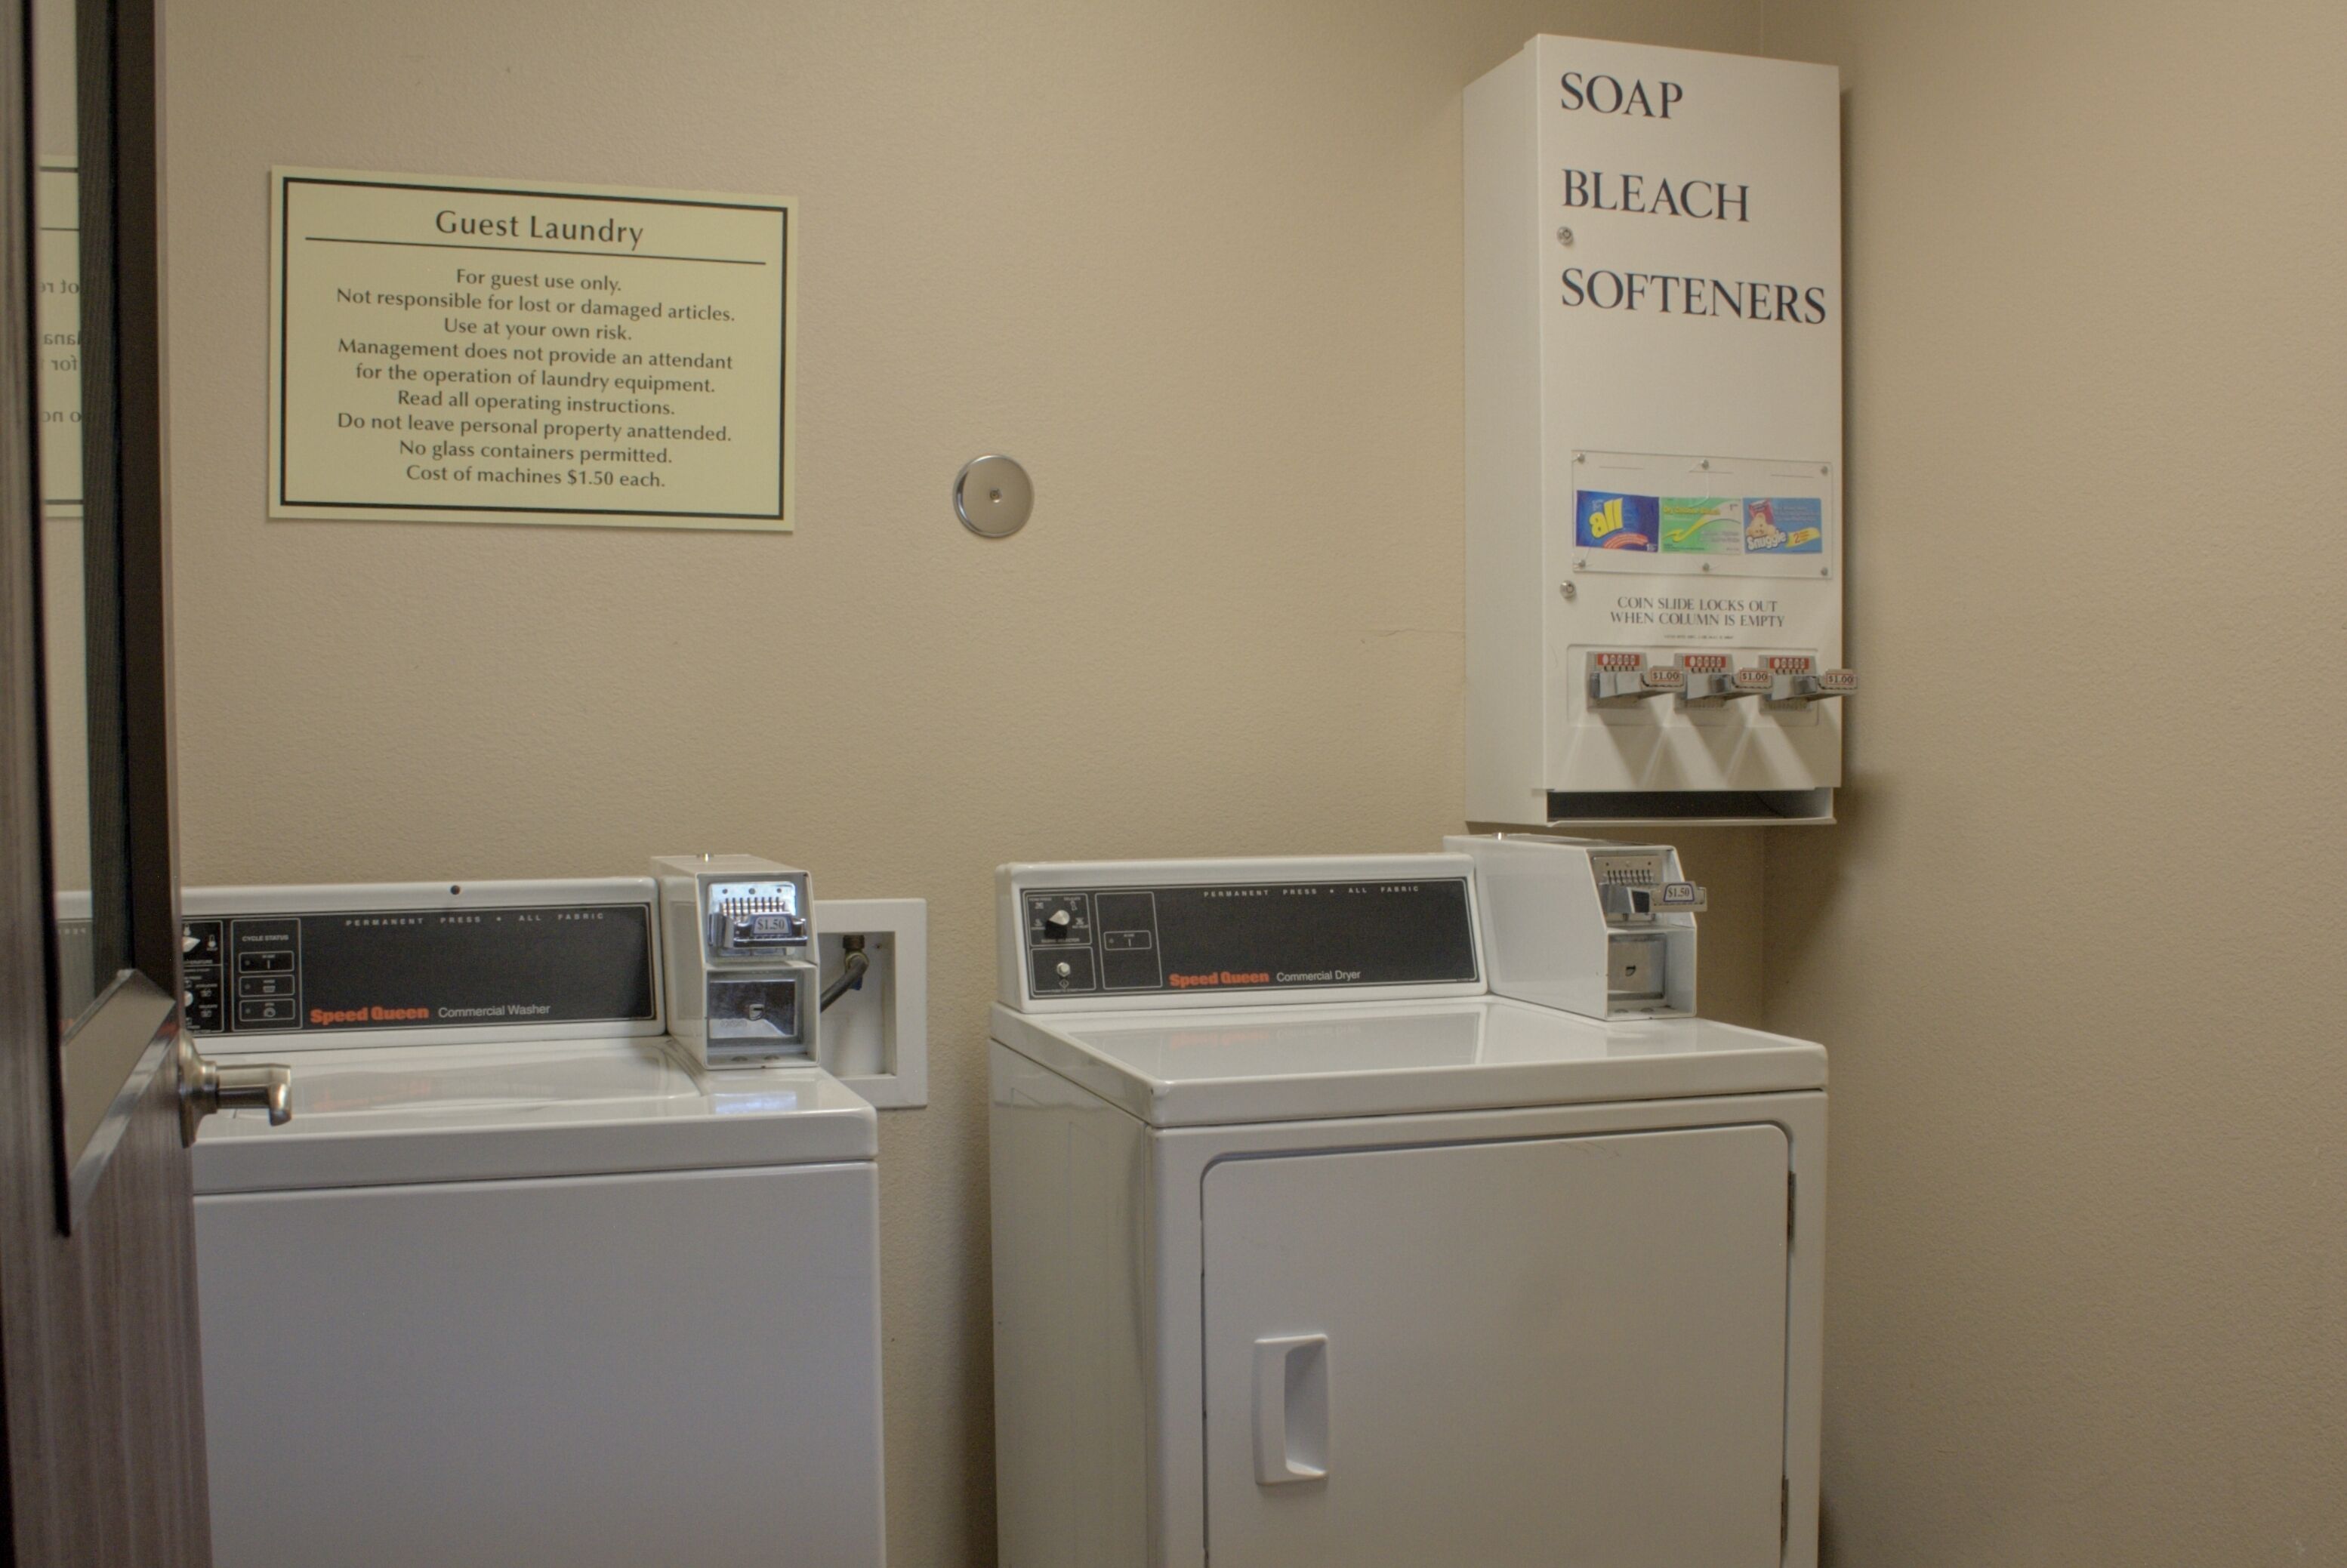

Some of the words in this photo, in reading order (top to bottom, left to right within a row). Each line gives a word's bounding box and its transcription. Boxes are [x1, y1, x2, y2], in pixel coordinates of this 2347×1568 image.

[1560, 72, 1682, 119] SOAP
[1562, 168, 1750, 222] BLEACH
[436, 210, 518, 237] Guest
[530, 215, 643, 251] Laundry
[457, 269, 486, 284] For
[491, 274, 538, 290] guest
[544, 277, 575, 289] use
[580, 275, 621, 293] only.
[338, 288, 371, 304] Not
[377, 292, 482, 311] responsible
[488, 294, 514, 310] for
[519, 295, 551, 313] lost
[556, 303, 575, 313] or
[581, 299, 662, 322] damaged
[668, 304, 735, 321] articles.
[1561, 268, 1826, 325] SOFTENERS
[444, 318, 477, 334] Use
[483, 321, 499, 334] at
[505, 324, 546, 340] your
[551, 326, 590, 338] own
[596, 325, 631, 340] risk.
[338, 338, 458, 360] Management
[464, 343, 507, 359] does
[514, 347, 543, 361] not
[549, 348, 616, 366] provide
[621, 353, 643, 365] an
[648, 353, 732, 369] attendant
[356, 365, 382, 379] for
[388, 365, 417, 380] the
[423, 368, 511, 387] operation
[517, 372, 535, 385] of
[541, 370, 609, 390] laundry
[614, 375, 714, 395] equipment.
[398, 390, 443, 406] Read
[449, 392, 468, 407] all
[474, 395, 562, 415] operating
[567, 399, 674, 414] instructions.
[338, 413, 365, 428] Do
[372, 416, 402, 430] not
[409, 414, 455, 432] leave
[461, 418, 538, 437] personal
[544, 424, 621, 442] property
[627, 425, 731, 442] anattended.
[400, 440, 427, 455] No
[432, 441, 475, 461] glass
[480, 444, 574, 460] containers
[580, 447, 672, 466] permitted.
[406, 464, 446, 481] Cost
[453, 466, 472, 481] of
[477, 467, 562, 484] machines
[567, 469, 614, 485] $1.50
[619, 471, 665, 487] each.
[1590, 498, 1624, 538] all
[1747, 531, 1787, 550] Snuggle
[1617, 596, 1653, 608] COIN
[1658, 598, 1693, 610] SLIDE
[1699, 599, 1744, 611] LOCKS
[1749, 600, 1778, 612] OUT
[1610, 611, 1654, 624] WHEN
[1658, 613, 1719, 626] COLUMN
[1724, 614, 1735, 626] IS
[1740, 615, 1783, 627] EMPTY
[1652, 671, 1679, 679] $1.00
[1741, 672, 1768, 681] $1.00
[1828, 674, 1853, 683] $1.00
[1203, 889, 1269, 898] PERMANENT
[1667, 887, 1690, 898] $1.50
[345, 917, 424, 926] PERMANENT
[439, 916, 481, 924] PRESS
[757, 918, 785, 931] $1.50
[1168, 972, 1219, 989] Speed
[1220, 971, 1270, 984] Queen
[1275, 970, 1333, 983] Commercial
[1334, 969, 1361, 982] Dryer
[310, 1006, 369, 1026] Speed
[370, 1006, 430, 1021] Queen
[437, 1005, 506, 1018] Commercial
[507, 1004, 551, 1015] Washer
